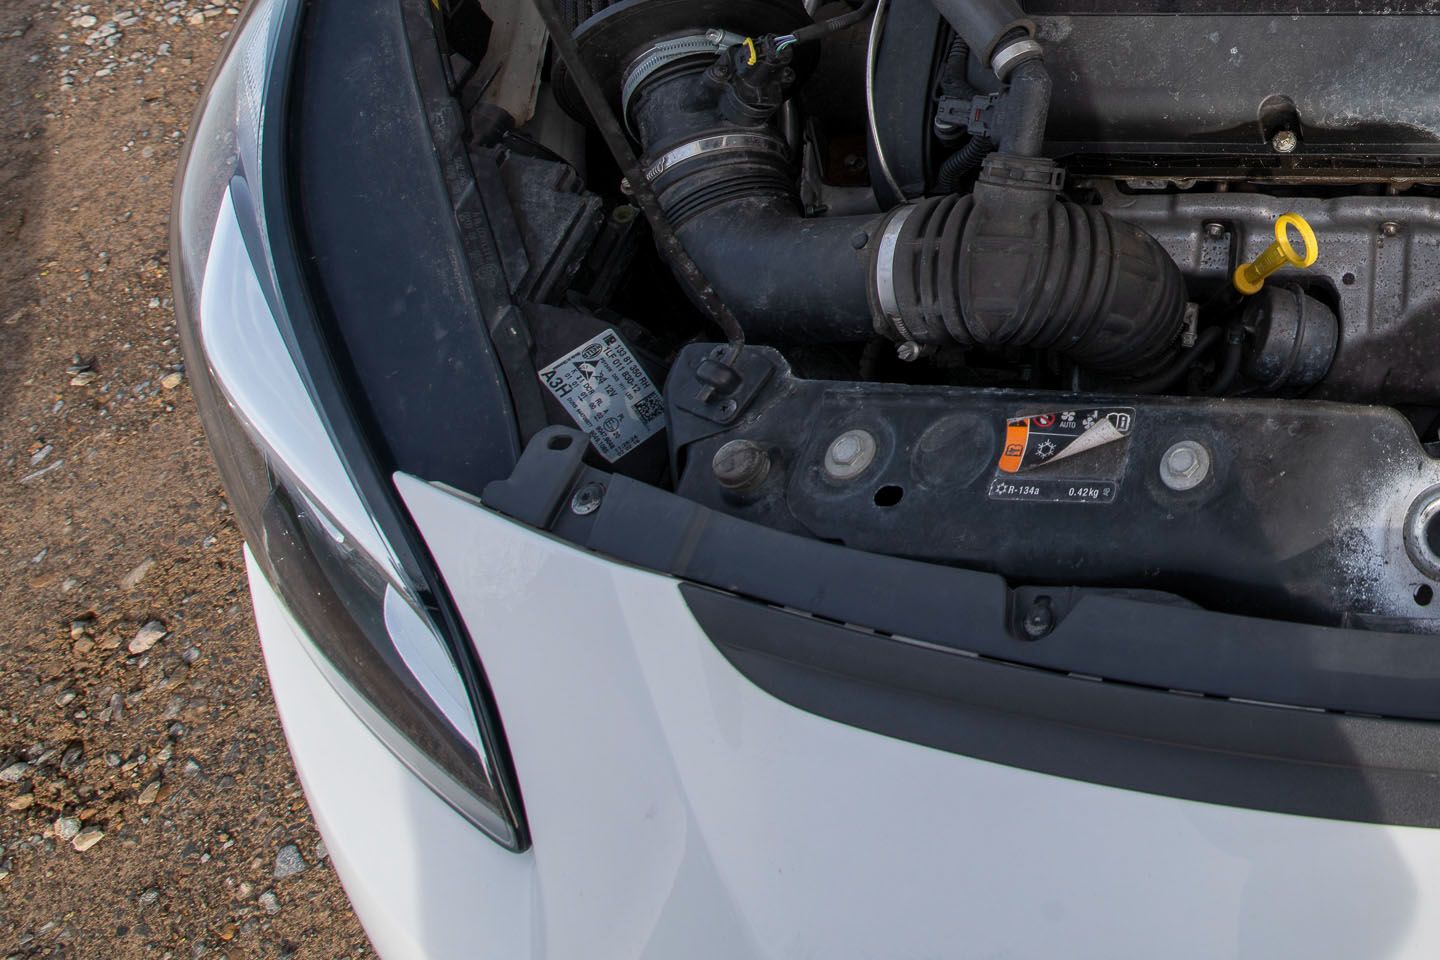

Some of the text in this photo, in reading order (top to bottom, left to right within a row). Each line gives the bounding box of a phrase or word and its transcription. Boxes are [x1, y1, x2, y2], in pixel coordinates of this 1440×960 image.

[603, 347, 617, 360] 1LF
[612, 358, 625, 372] 011
[614, 344, 651, 389] 133 81 350 RH
[541, 369, 572, 398] A3H
[604, 383, 618, 398] 12V
[1007, 486, 1039, 495] R-134a
